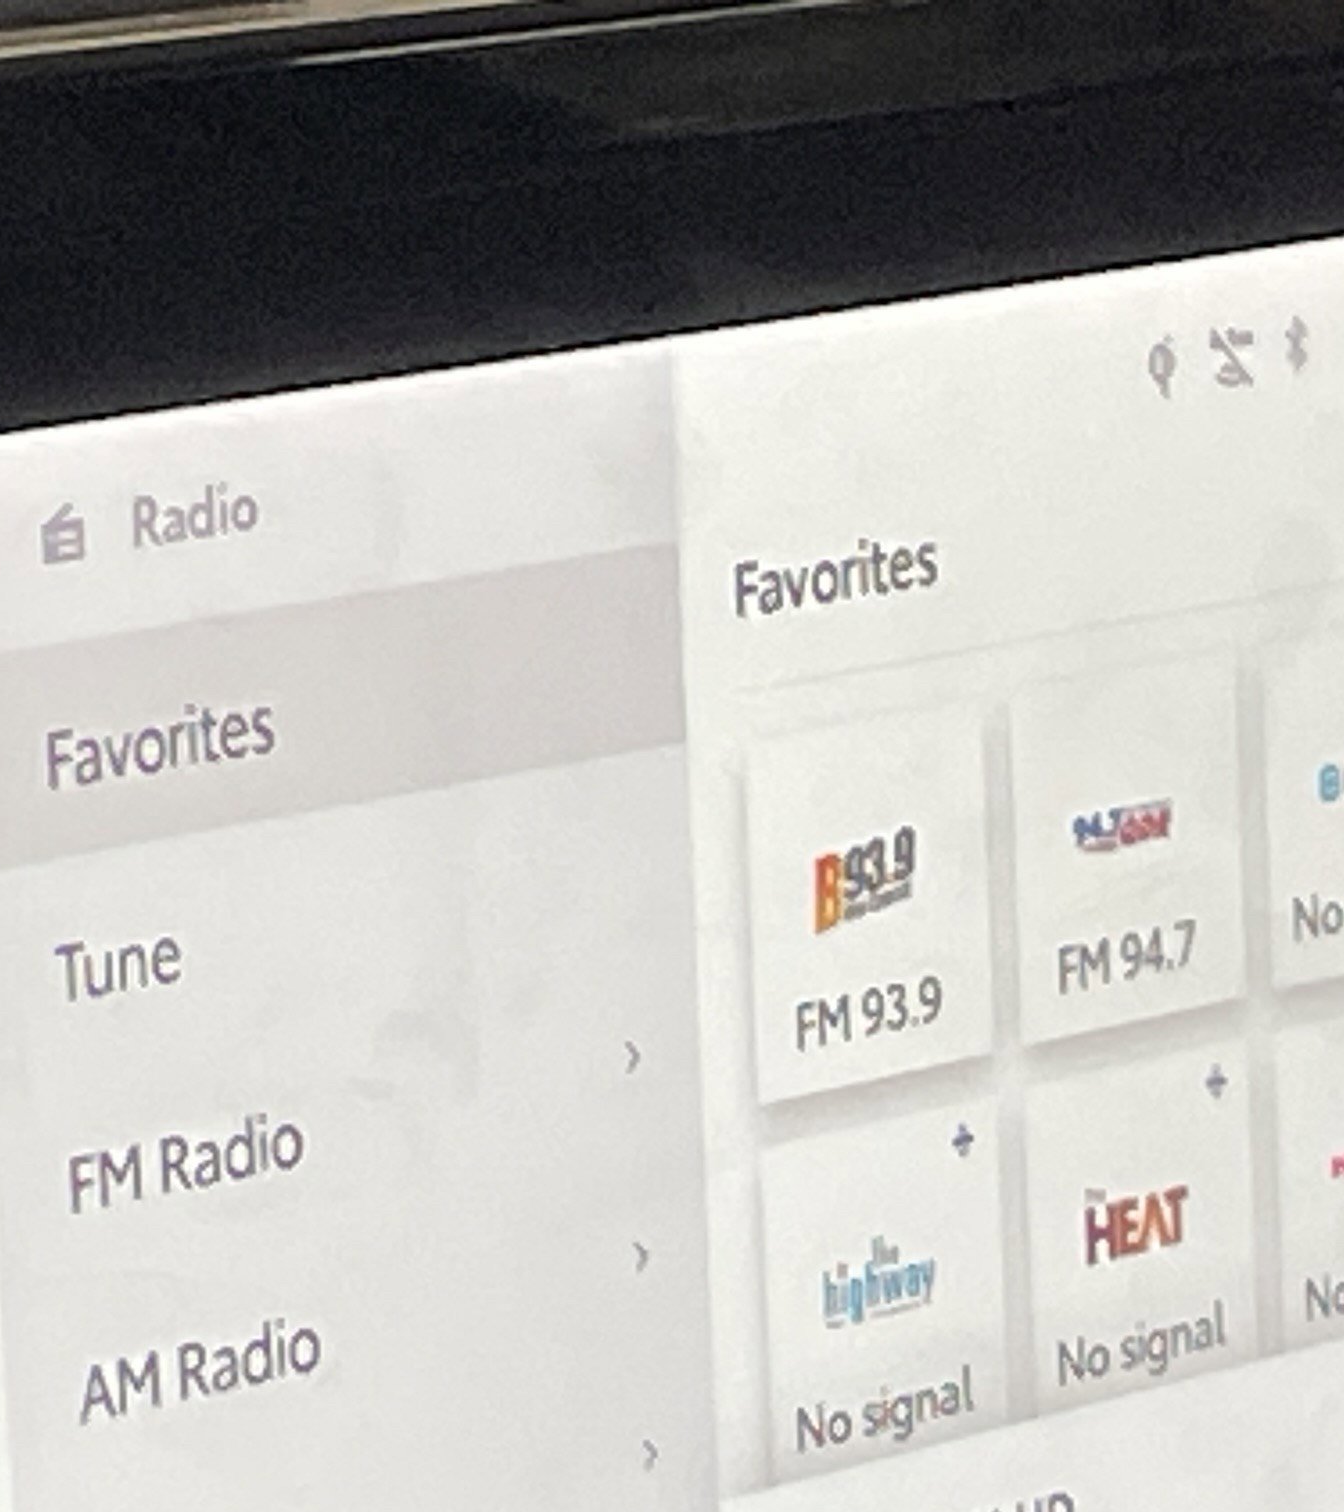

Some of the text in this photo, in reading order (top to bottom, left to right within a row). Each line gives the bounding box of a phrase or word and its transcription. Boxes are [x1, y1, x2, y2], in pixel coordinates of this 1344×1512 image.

[132, 481, 259, 547] Radio
[734, 539, 938, 616] Favorites
[46, 703, 276, 790] Favorites
[1293, 892, 1344, 943] No
[55, 932, 183, 1001] Tune
[1057, 918, 1196, 996] FM 94.7
[795, 975, 942, 1052] FM 93.9
[68, 1112, 305, 1214] FM Radio
[1085, 1184, 1189, 1266] HEAT
[823, 1257, 935, 1326] highway
[79, 1318, 322, 1425] AM Radio
[1057, 1301, 1227, 1386] No signal
[797, 1364, 975, 1453] No signal
